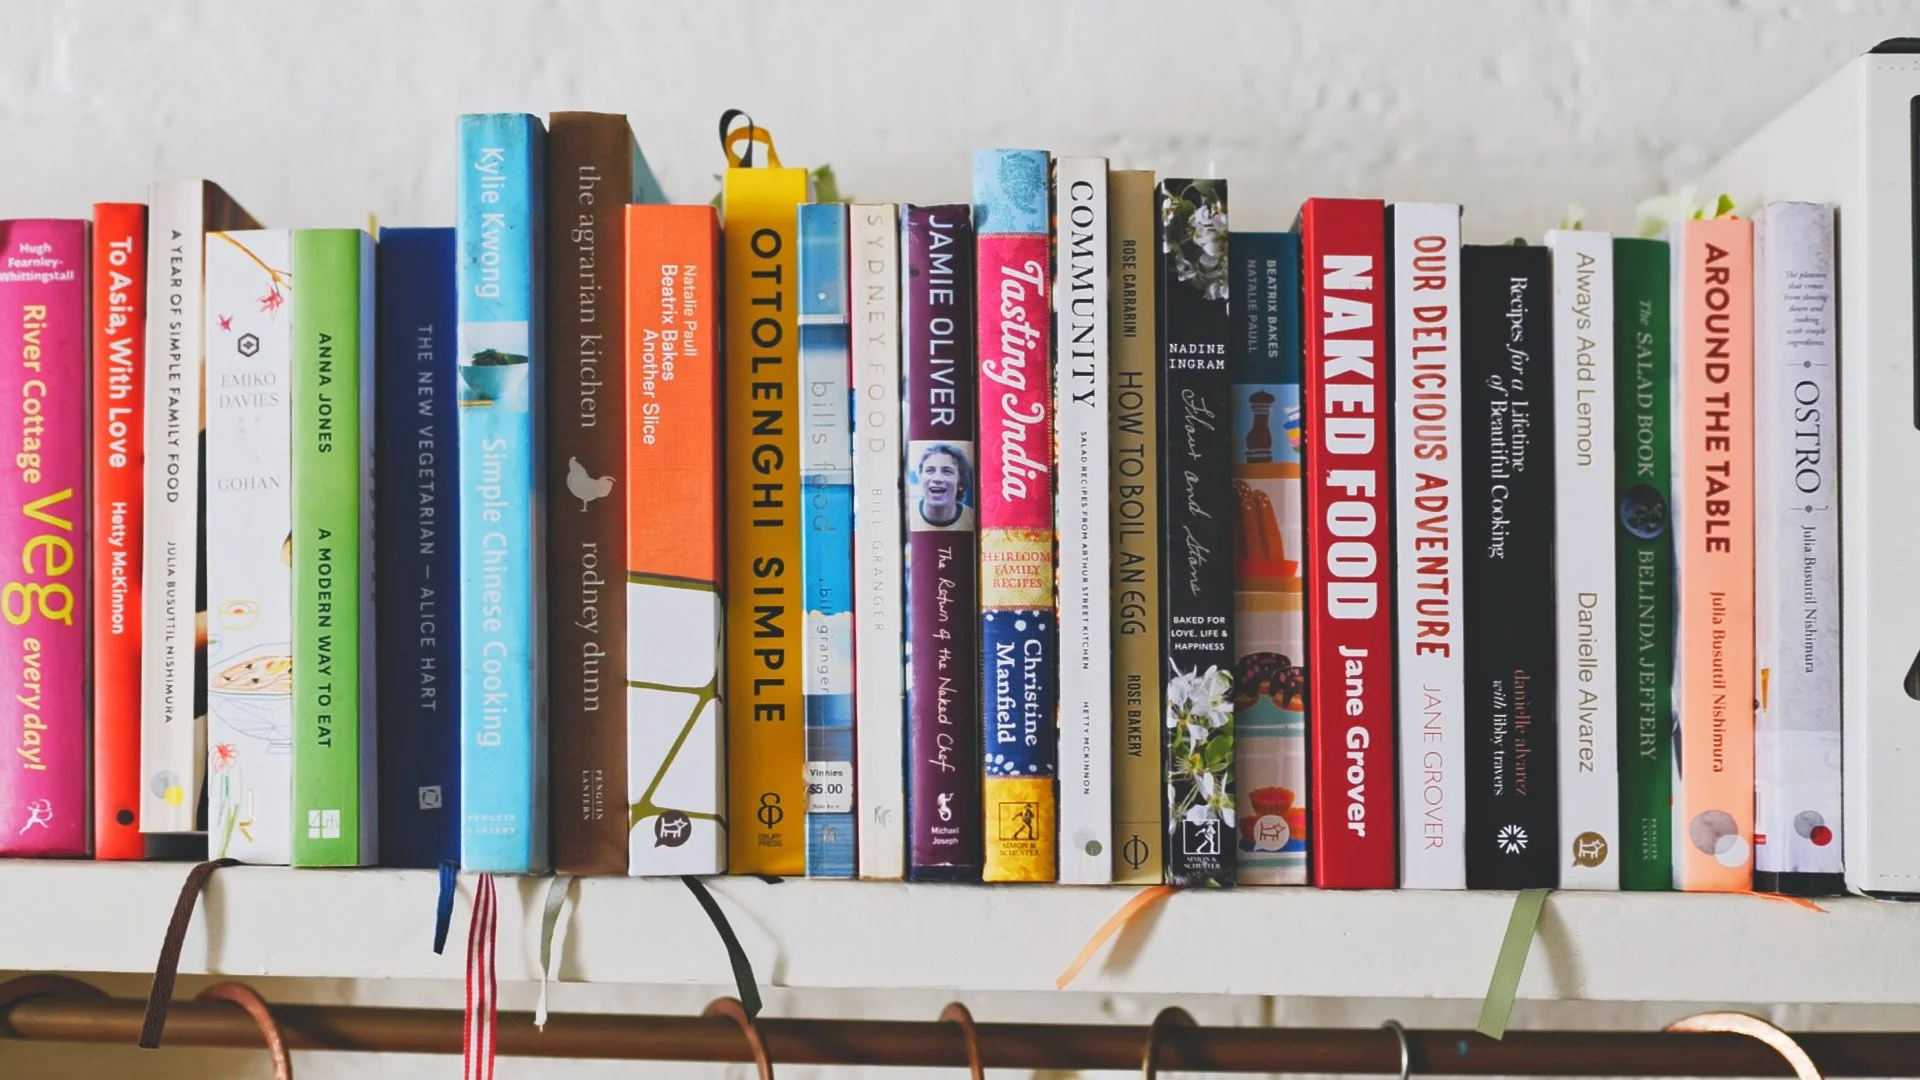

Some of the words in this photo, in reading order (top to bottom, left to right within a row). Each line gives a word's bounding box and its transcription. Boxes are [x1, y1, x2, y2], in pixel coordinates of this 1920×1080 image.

[474, 147, 505, 204] Kylie
[578, 166, 601, 205] the
[8, 256, 64, 269] Fearnley-
[20, 243, 52, 256] Hugh
[109, 236, 134, 267] To
[171, 230, 181, 240] A
[476, 213, 506, 298] Kwong
[929, 215, 954, 306] JAMIE
[1122, 240, 1136, 270] ROSE
[1412, 235, 1447, 292] OUR
[171, 245, 182, 290] YEAR
[571, 215, 602, 323] agrarian
[661, 264, 678, 324] Beatrix
[683, 264, 697, 317] Natalie
[867, 215, 884, 346] SYDNEY
[1070, 181, 1095, 408] COMMUNITY
[1247, 260, 1258, 310] NATALIE
[1266, 260, 1278, 313] BEATRIX
[1572, 251, 1596, 330] Always
[104, 270, 134, 335] Asia,
[170, 293, 182, 316] OF
[981, 260, 1045, 392] Tasting
[1122, 275, 1137, 338] CARRARINI
[1506, 276, 1528, 342] Recipes
[1638, 300, 1652, 326] The
[1705, 242, 1730, 384] AROUND
[22, 305, 47, 372] River
[169, 321, 181, 380] SIMPLE
[319, 333, 331, 387] ANNA
[417, 324, 433, 361] THE
[661, 329, 678, 381] Bakes
[684, 321, 697, 356] Paull
[1169, 343, 1225, 355] NADINE
[1248, 314, 1258, 353] PAULL
[1267, 316, 1278, 358] BAKES
[1323, 255, 1375, 455] NAKED
[1506, 344, 1529, 375] for
[1576, 336, 1596, 382] Add
[108, 337, 135, 401] With
[221, 372, 276, 388] EMIKO
[580, 327, 603, 428] kitchen
[643, 329, 659, 399] Another
[751, 228, 784, 527] OTTOLENGHI
[930, 318, 955, 426] OLIVER
[1169, 358, 1225, 370] INGRAM
[1412, 305, 1448, 462] DELICIOUS
[1485, 374, 1508, 397] of
[1511, 379, 1524, 391] a
[1636, 332, 1653, 409] SALAD
[168, 387, 181, 449] FAMILY
[219, 393, 279, 409] DAVIES
[318, 393, 331, 454] JONES
[418, 371, 433, 418] NEW
[811, 381, 835, 445] bills
[867, 364, 885, 453] FOOD
[1118, 371, 1143, 434] HOW
[1705, 392, 1730, 452] THE
[17, 380, 47, 484] Cottage
[108, 407, 133, 469] Love
[643, 403, 659, 446] Slice
[1001, 393, 1048, 503] India
[1490, 400, 1510, 479] Beautiful
[1511, 401, 1529, 472] Lifetime
[1576, 389, 1596, 467] Lemon
[1637, 414, 1654, 477] BOOK
[1795, 380, 1821, 494] OSTRO
[167, 454, 179, 503] FOOD
[217, 476, 281, 492] GOHAN
[418, 425, 435, 554] VEGETARIAN
[477, 438, 508, 523] Simple
[1118, 444, 1144, 477] TO
[109, 501, 128, 548] Hetty
[812, 462, 836, 532] food
[872, 488, 883, 526] BILL
[1119, 485, 1145, 544] BOIL
[1185, 471, 1212, 519] and
[1488, 485, 1510, 559] Cooking
[1705, 461, 1730, 553] TABLE
[167, 541, 176, 577] JULIA
[318, 528, 331, 541] A
[937, 547, 952, 570] The
[982, 552, 1050, 562] HEIRLOOM
[1326, 469, 1378, 620] FOOD
[1801, 524, 1816, 553] Julia
[111, 551, 128, 635] McKinnon
[318, 548, 331, 628] MODERN
[483, 532, 508, 632] Chinese
[574, 543, 605, 633] rodney
[872, 540, 884, 632] GRANGER
[993, 578, 1042, 588] RECIPES
[995, 565, 1041, 575] FAMILY
[1120, 551, 1146, 583] AN
[1414, 472, 1450, 658] ADVENTURE
[1804, 557, 1817, 605] Busuttil
[166, 580, 176, 642] BUSUTTIL
[420, 587, 436, 647] ALICE
[938, 577, 956, 622] Return
[1120, 591, 1146, 635] EGG
[1173, 616, 1204, 625] BAKED
[1206, 616, 1226, 625] FOR
[1638, 551, 1655, 652] BELINDA
[1710, 591, 1726, 626] Julia
[318, 635, 331, 676] WAY
[753, 557, 785, 722] SIMPLE
[817, 624, 831, 692] granger
[932, 629, 951, 641] of
[938, 648, 952, 671] the
[1174, 643, 1225, 651] HAPPINESS
[1200, 630, 1219, 638] LIFE
[1221, 630, 1228, 638] &
[1578, 592, 1598, 683] Danielle
[1712, 630, 1727, 689] Busuttil
[1804, 608, 1817, 673] Nishimura
[16, 636, 48, 771] everyday!
[164, 646, 174, 724] NISHIMURA
[317, 683, 331, 707] TO
[420, 657, 436, 711] HART
[476, 641, 508, 748] Cooking
[583, 641, 606, 712] dunn
[937, 677, 958, 725] Naked
[996, 642, 1017, 744] Manfield
[1023, 638, 1042, 746] Christine
[1127, 674, 1141, 706] ROSE
[1339, 645, 1368, 717] Jane
[1493, 680, 1507, 709] with
[1514, 668, 1532, 733] danielle
[317, 714, 331, 748] EAT
[1128, 709, 1142, 758] BAKERY
[1423, 684, 1442, 743] JANE
[1490, 713, 1508, 745] libby
[1578, 688, 1598, 773] Alvarez
[1639, 658, 1656, 760] JEFFERY
[1712, 694, 1727, 773] Nishimura
[928, 733, 956, 773] Chef
[1346, 726, 1370, 838] Grover
[1493, 750, 1506, 797] travers
[1514, 738, 1531, 797] alvarez
[809, 784, 843, 795] $5.00
[1423, 751, 1444, 850] GROVER
[931, 826, 960, 835] Michael
[932, 837, 959, 846] Joseph
